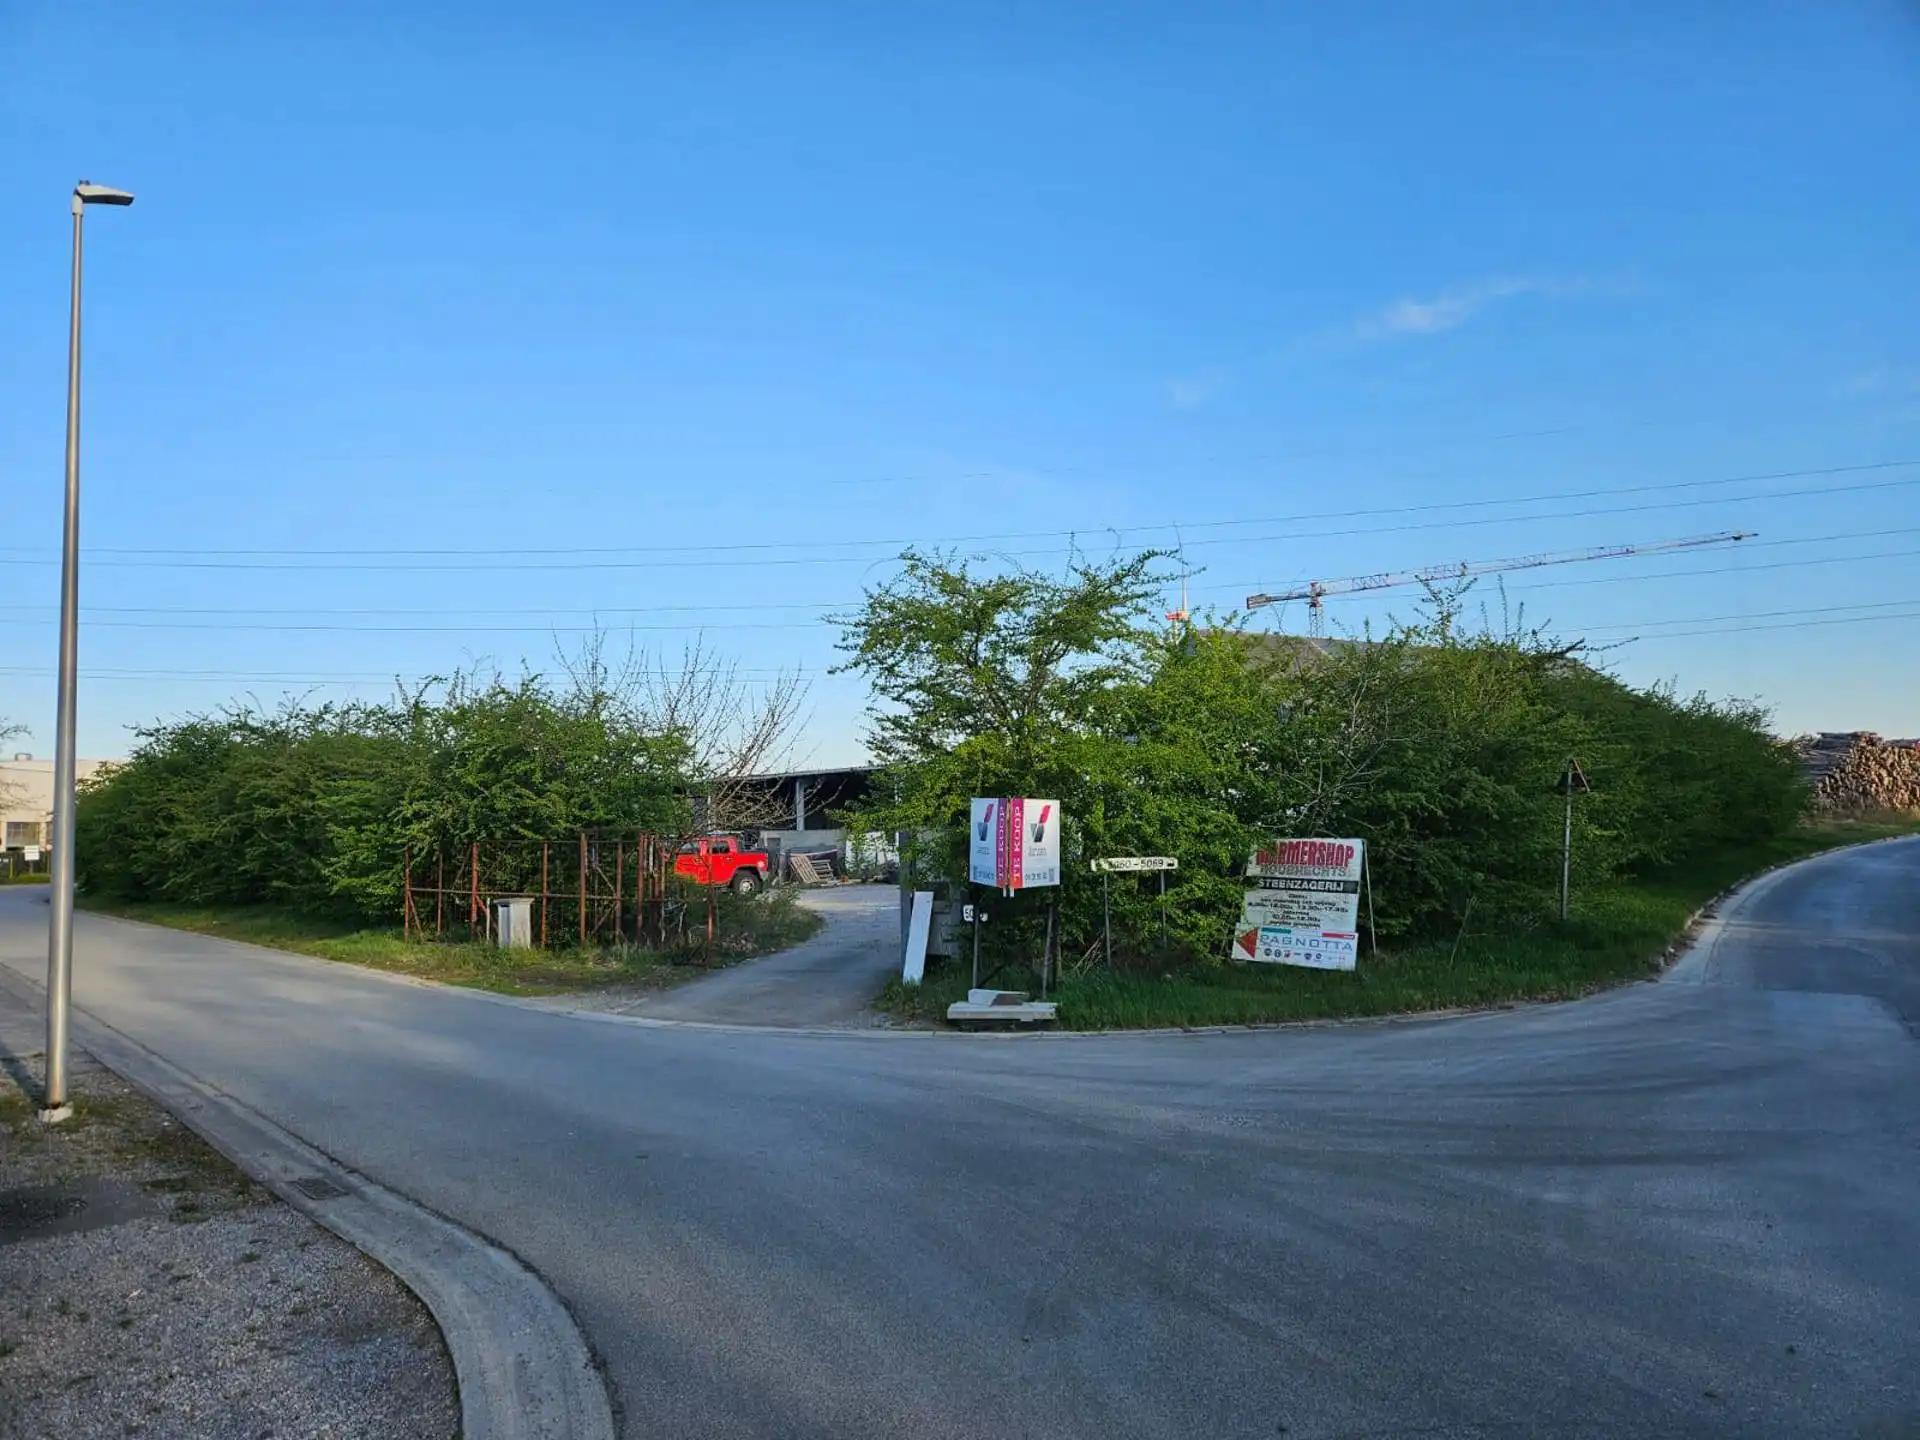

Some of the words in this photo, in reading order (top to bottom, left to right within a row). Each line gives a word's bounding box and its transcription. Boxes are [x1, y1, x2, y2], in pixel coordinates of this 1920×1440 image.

[1013, 806, 1022, 852] KOOP
[1255, 840, 1355, 867] MRMERSHOP
[1012, 857, 1021, 882] TE
[1259, 878, 1345, 892] STEENZAGERIJ
[1260, 934, 1353, 951] PAGNOTTA
